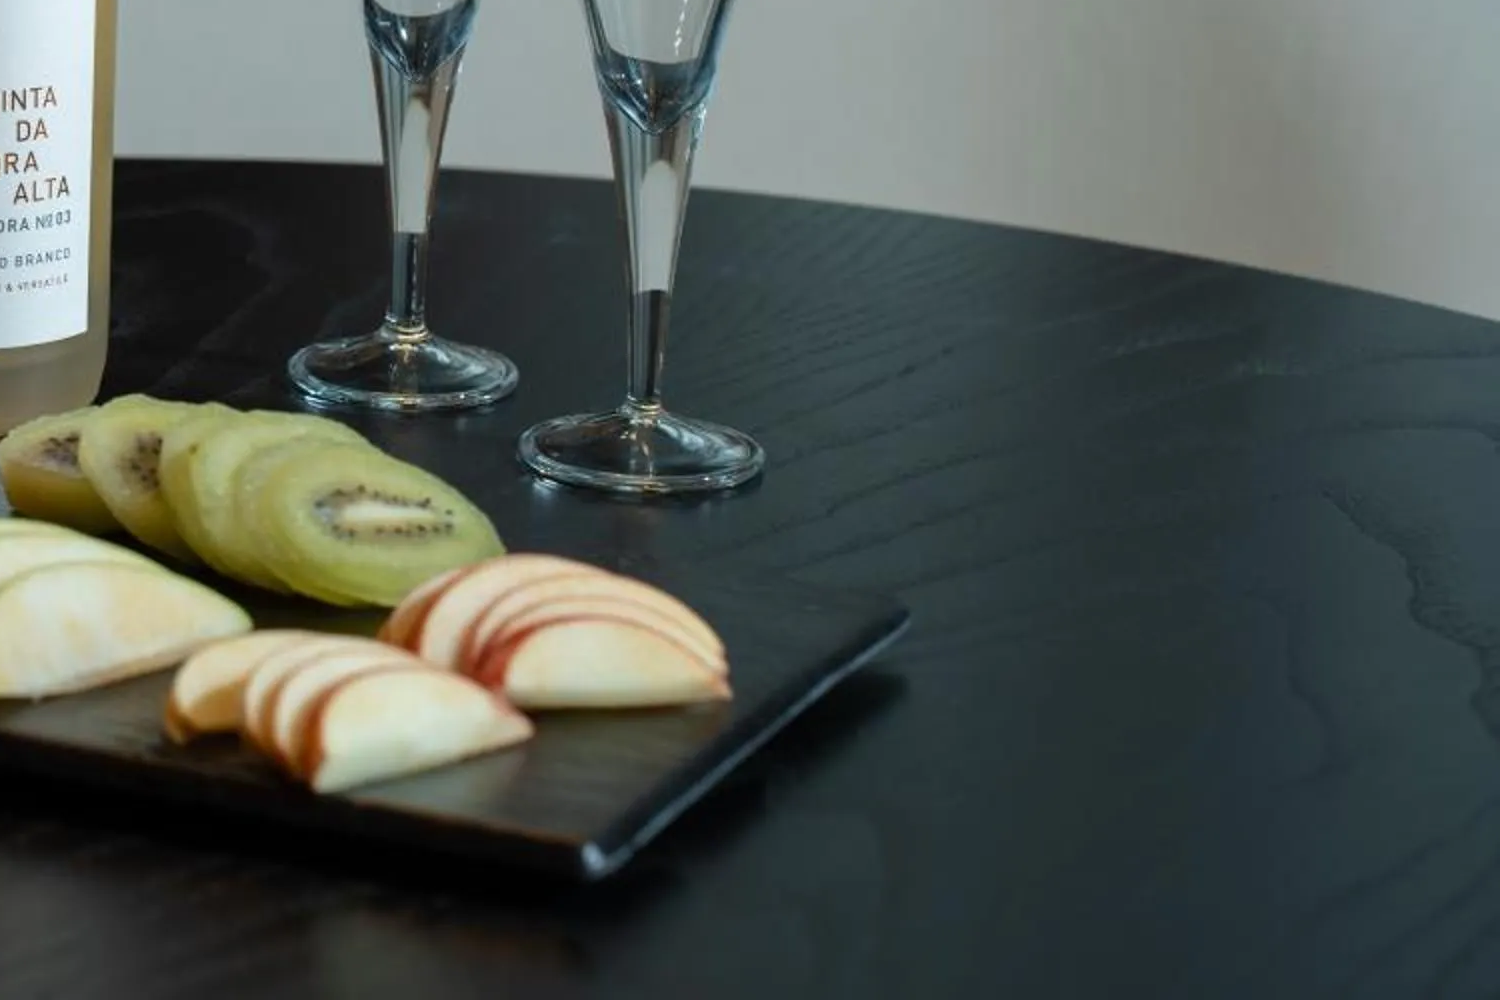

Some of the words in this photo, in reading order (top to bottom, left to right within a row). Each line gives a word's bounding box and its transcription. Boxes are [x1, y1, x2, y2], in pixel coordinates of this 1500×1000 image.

[17, 118, 48, 142] DA
[14, 176, 69, 204] ALTA
[14, 247, 71, 268] BRANCO
